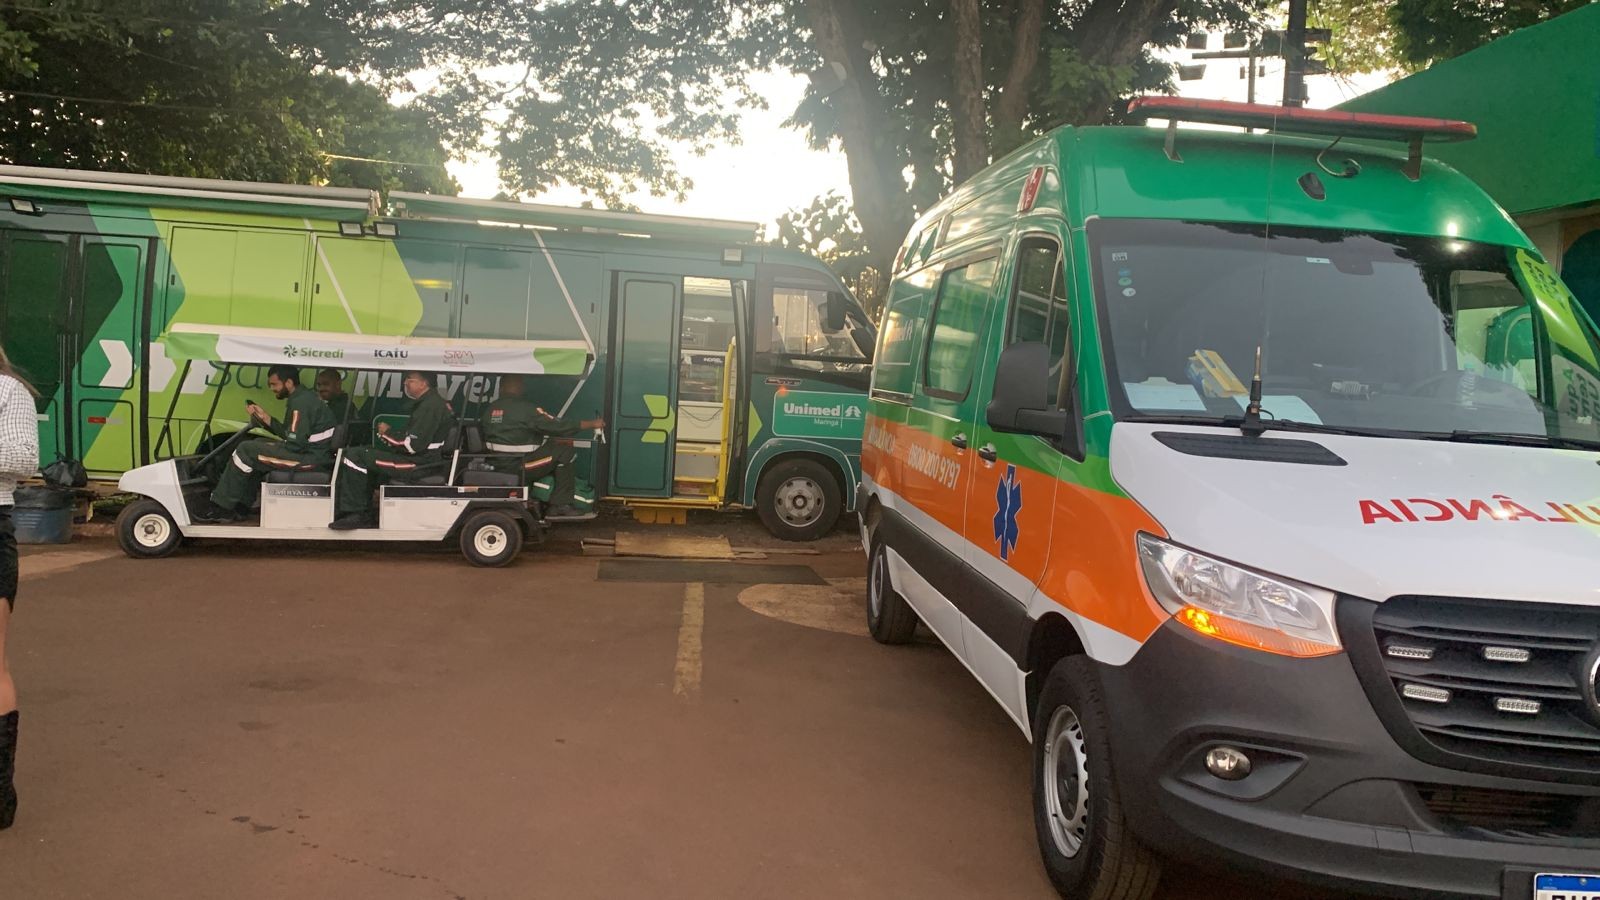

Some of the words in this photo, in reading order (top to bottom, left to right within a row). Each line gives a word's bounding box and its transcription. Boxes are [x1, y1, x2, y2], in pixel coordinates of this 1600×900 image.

[300, 347, 344, 359] Sicredi
[784, 403, 841, 417] Unimed
[924, 450, 940, 480] 200
[938, 456, 961, 491] 9797
